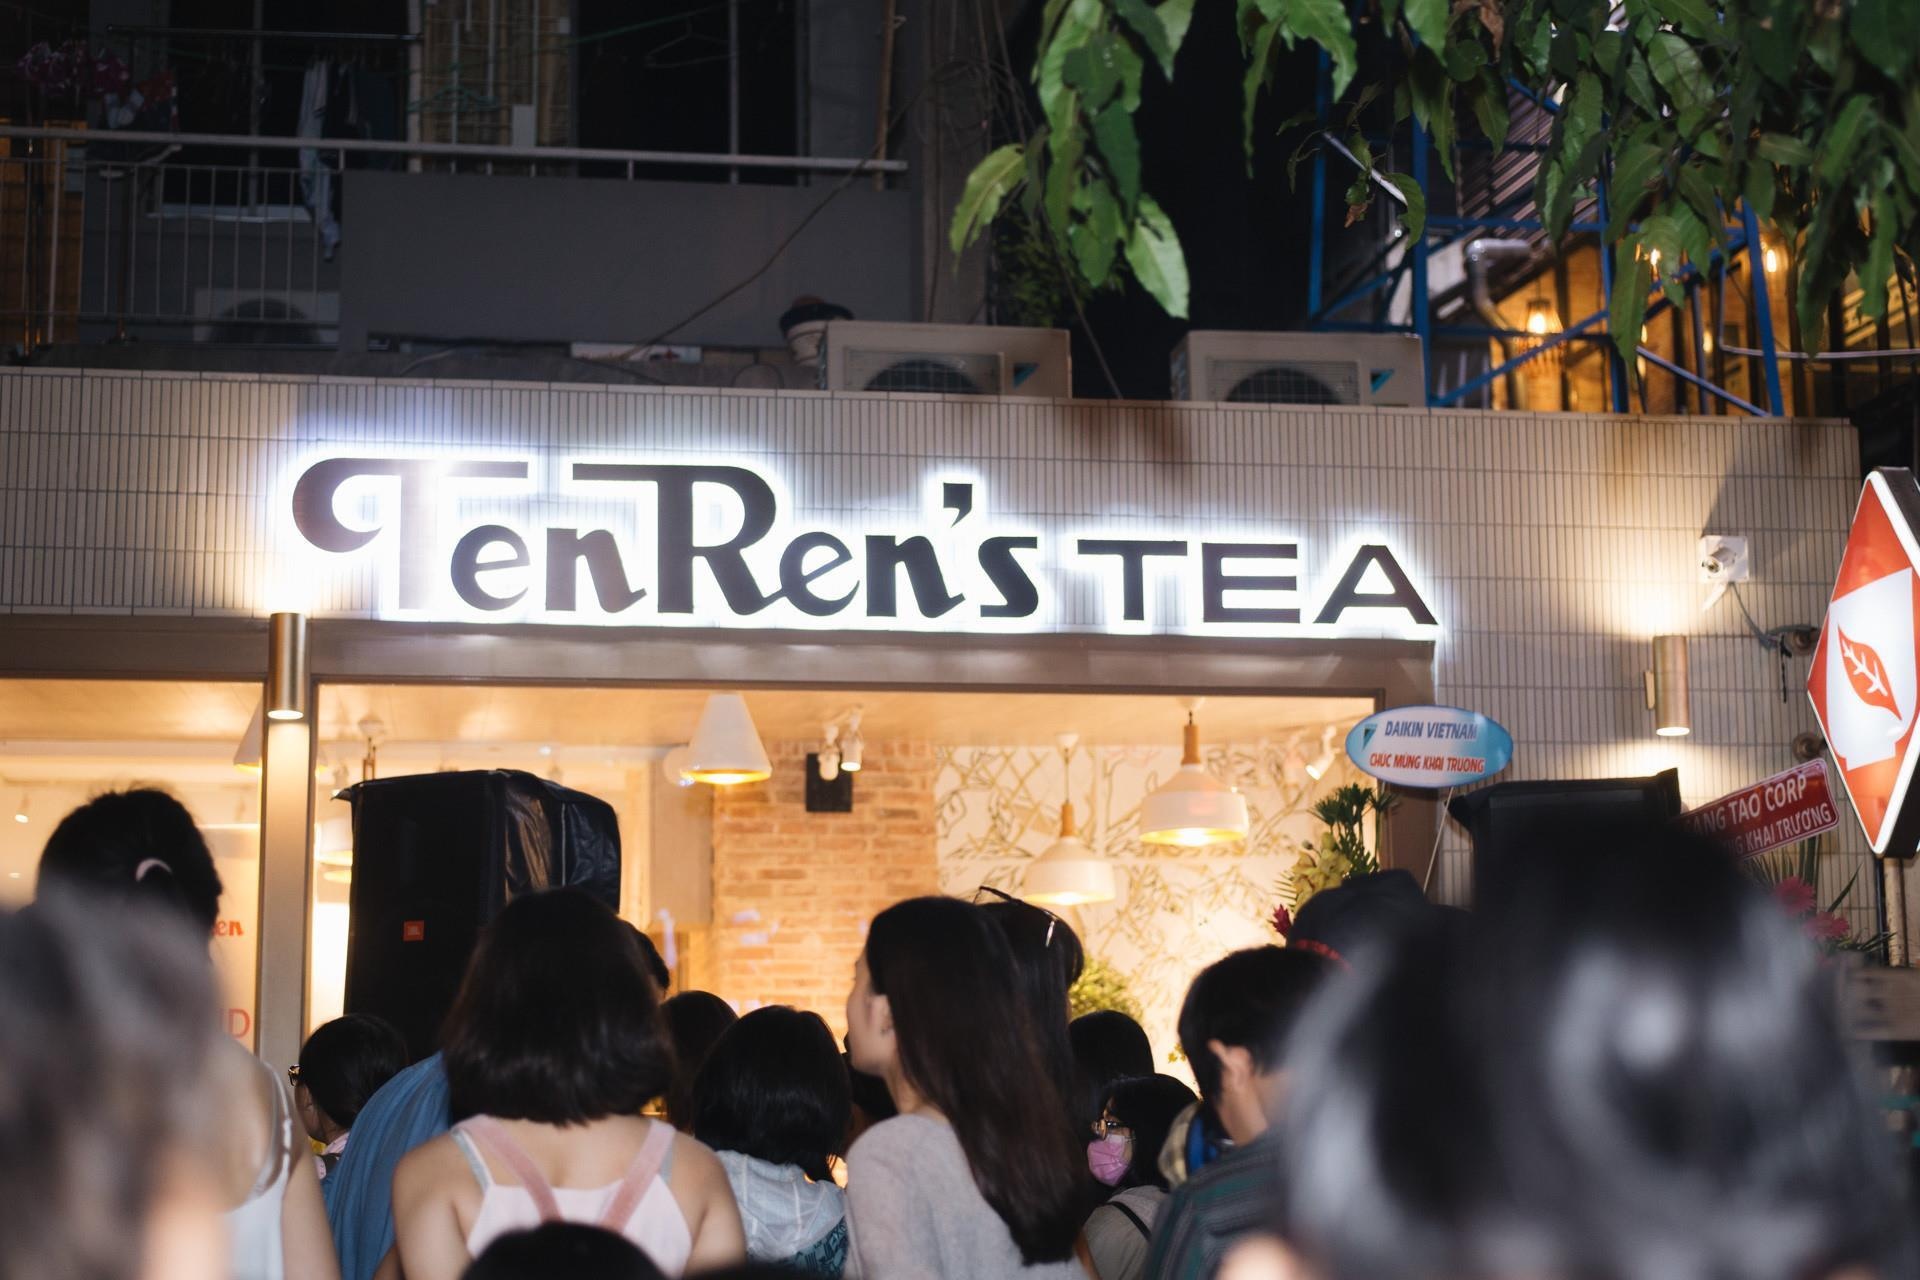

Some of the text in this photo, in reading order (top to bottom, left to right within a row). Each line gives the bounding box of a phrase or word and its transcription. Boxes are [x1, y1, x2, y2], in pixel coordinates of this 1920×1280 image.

[1077, 539, 1439, 626] TEA
[1385, 720, 1478, 740] DAIKIN VIETNAM
[1423, 754, 1444, 771] KHAI
[1764, 774, 1807, 812] CORP
[1744, 824, 1776, 852] KHAI
[1776, 803, 1832, 841] TRƯƠNG
